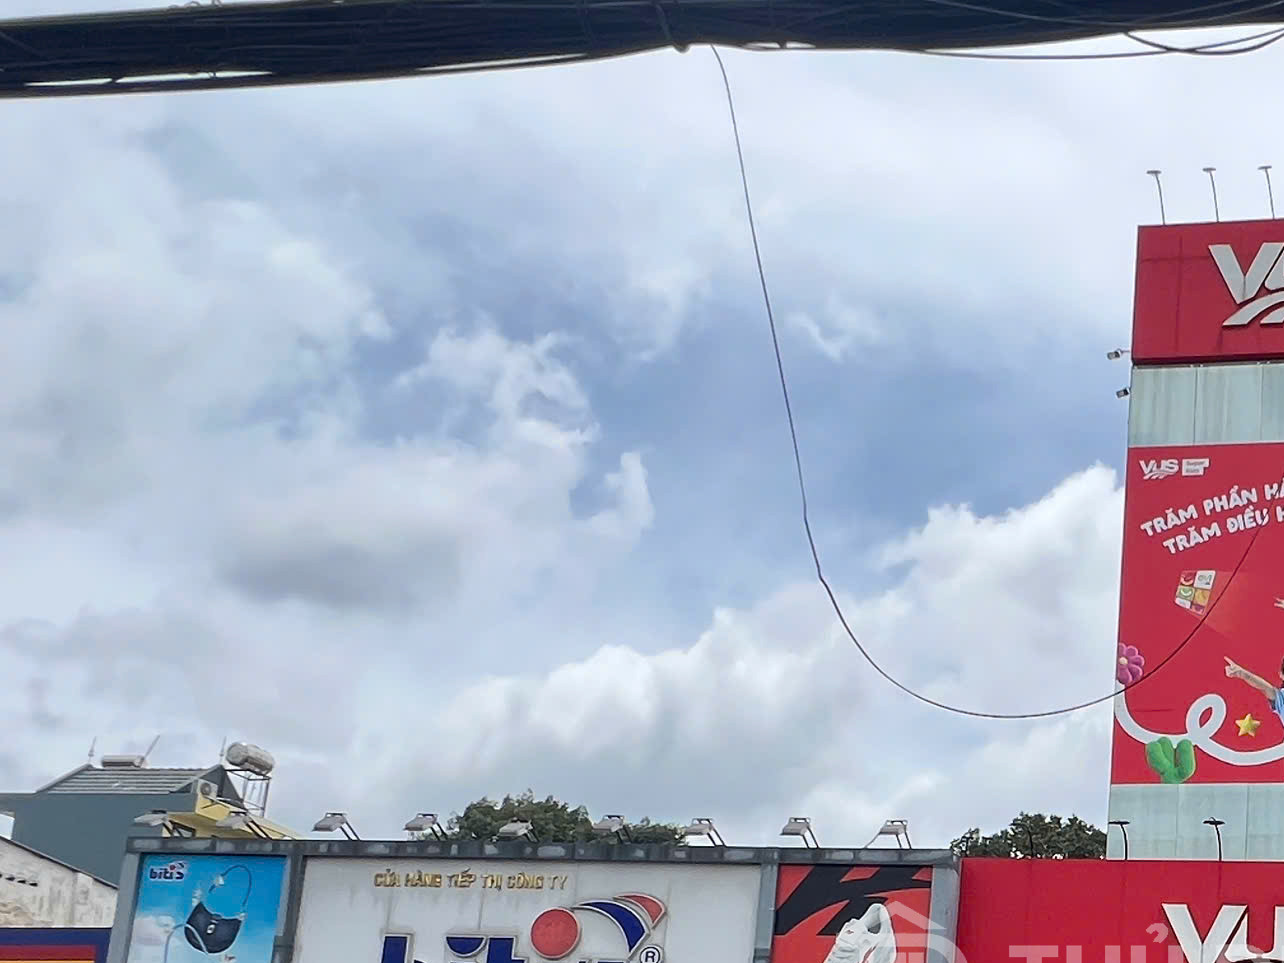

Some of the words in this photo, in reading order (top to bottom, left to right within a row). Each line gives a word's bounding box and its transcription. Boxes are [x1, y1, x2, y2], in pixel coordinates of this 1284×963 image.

[1139, 458, 1180, 475] VUS
[1140, 504, 1198, 536] TRĂM
[1163, 522, 1222, 554] TRĂM
[374, 869, 400, 888] CỬA
[404, 870, 442, 888] HÀNG
[447, 869, 477, 888] TIẾP
[507, 871, 544, 889] CÔNG
[548, 875, 568, 889] TY
